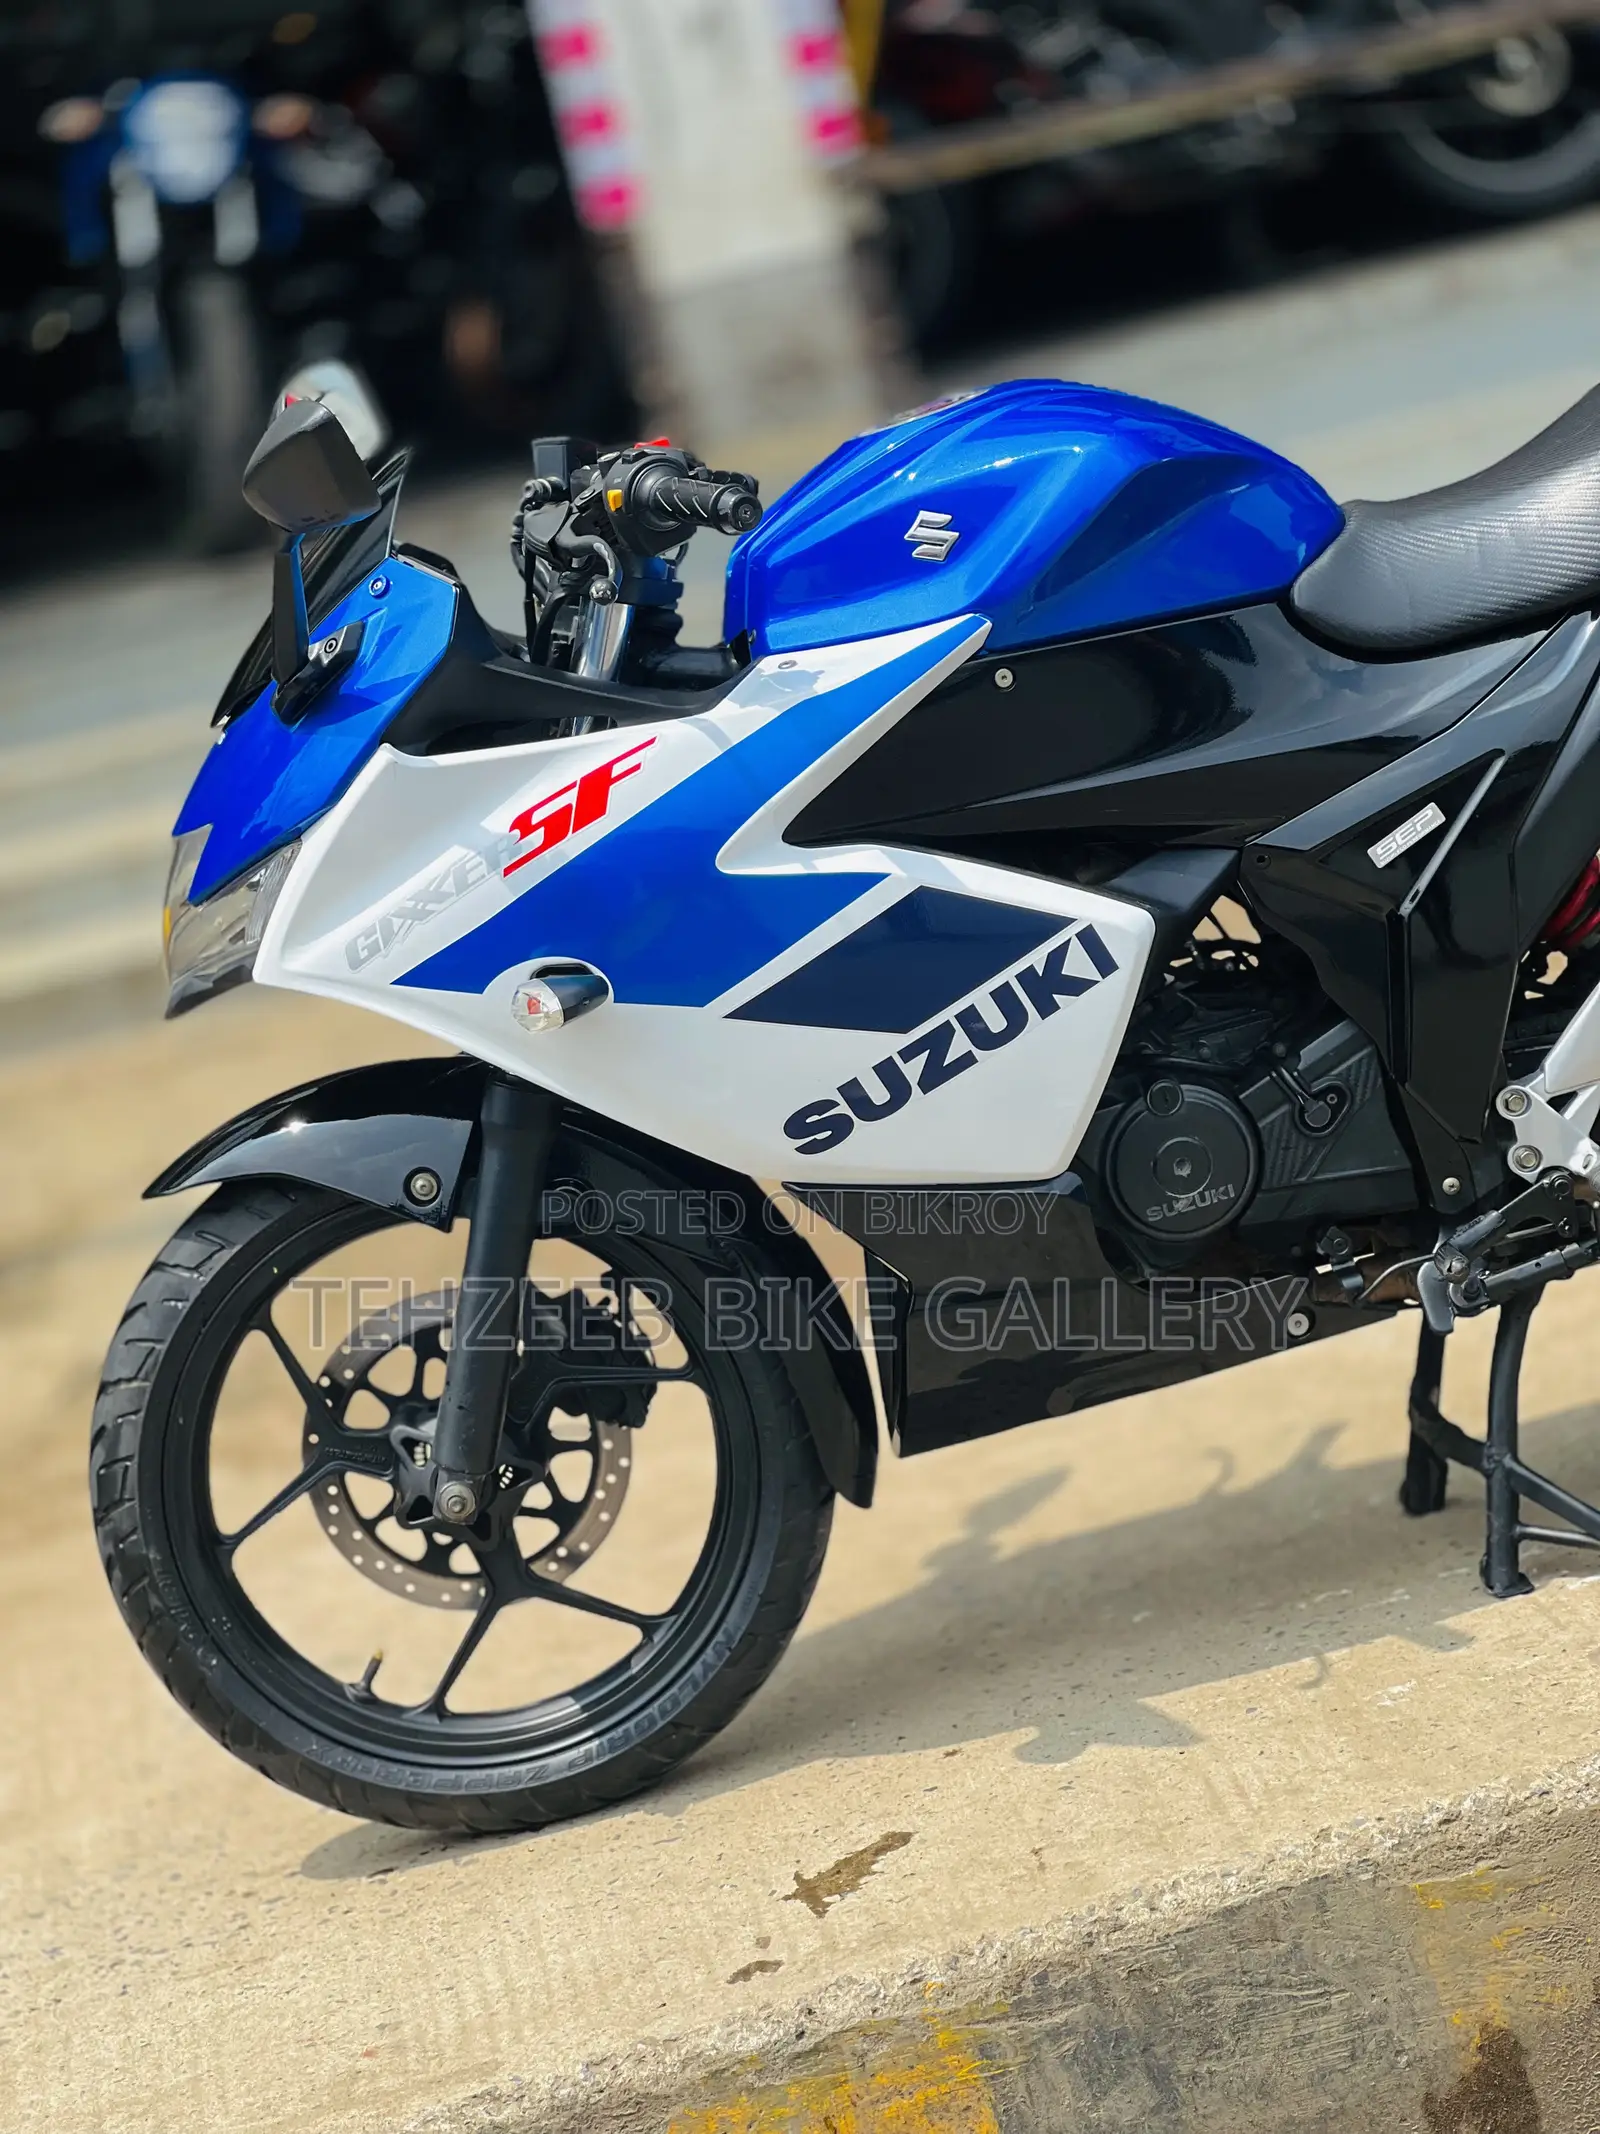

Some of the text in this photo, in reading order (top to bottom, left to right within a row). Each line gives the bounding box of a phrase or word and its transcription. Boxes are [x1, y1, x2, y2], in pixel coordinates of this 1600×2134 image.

[503, 736, 657, 878] SF
[1376, 808, 1433, 860] SEP
[783, 924, 1119, 1155] SUZUKI
[1146, 1184, 1235, 1221] SUZUKI
